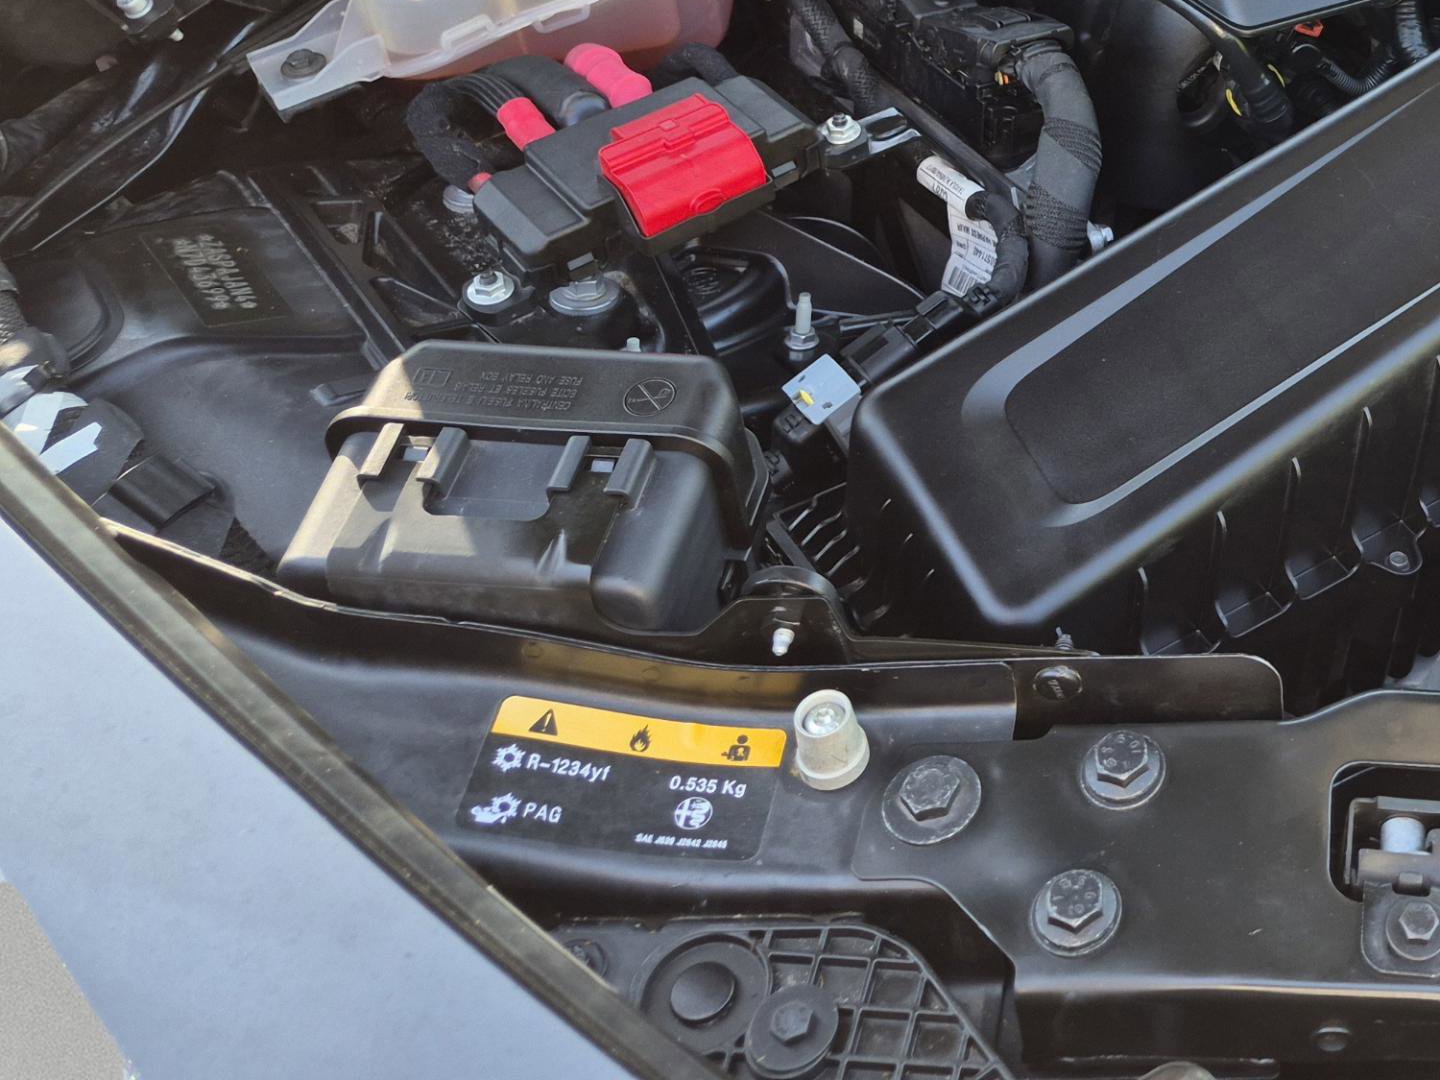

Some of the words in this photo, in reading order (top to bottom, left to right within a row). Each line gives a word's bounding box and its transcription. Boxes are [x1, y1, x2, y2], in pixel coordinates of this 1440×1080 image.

[526, 753, 611, 782] R-1234yf
[669, 775, 718, 793] 0.535
[721, 779, 747, 798] Kg
[522, 802, 562, 824] PAG
